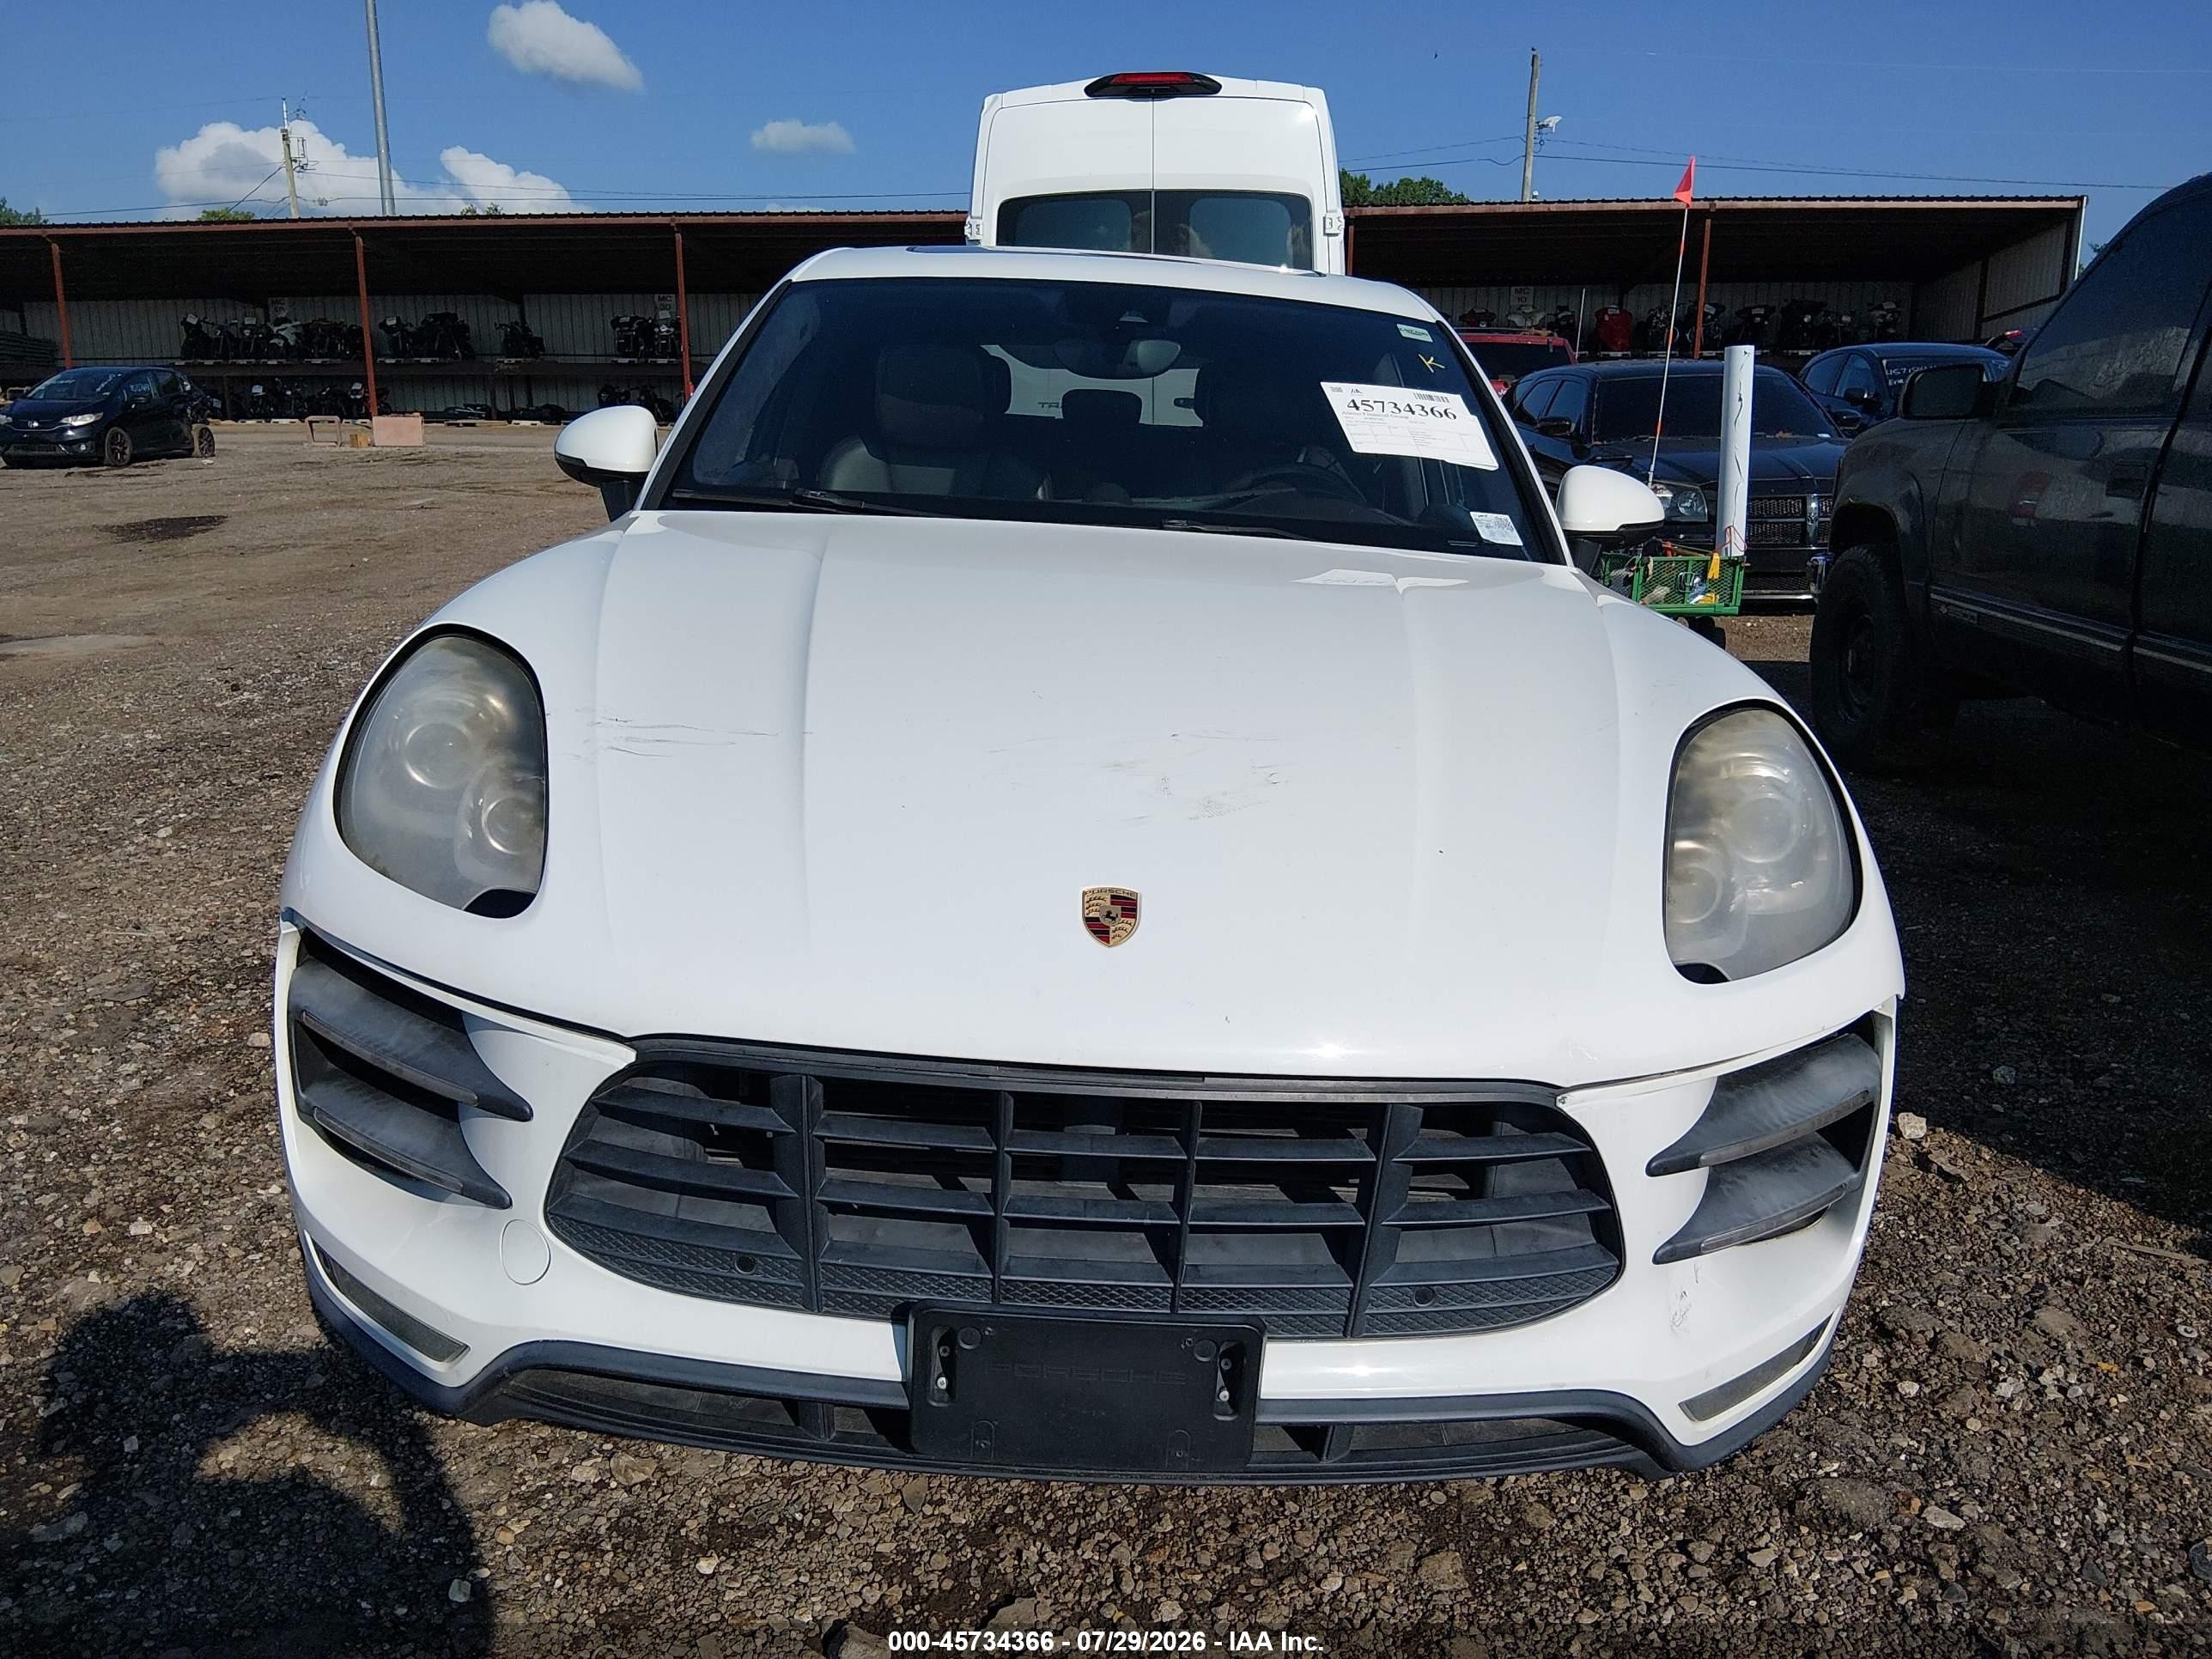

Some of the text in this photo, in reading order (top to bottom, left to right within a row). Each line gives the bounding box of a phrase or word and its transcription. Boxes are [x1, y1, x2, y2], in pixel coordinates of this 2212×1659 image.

[1418, 353, 1446, 374] K
[1347, 398, 1457, 421] 45734366
[1085, 887, 1137, 897] PORSCHE
[984, 1360, 1190, 1386] PORSCHE
